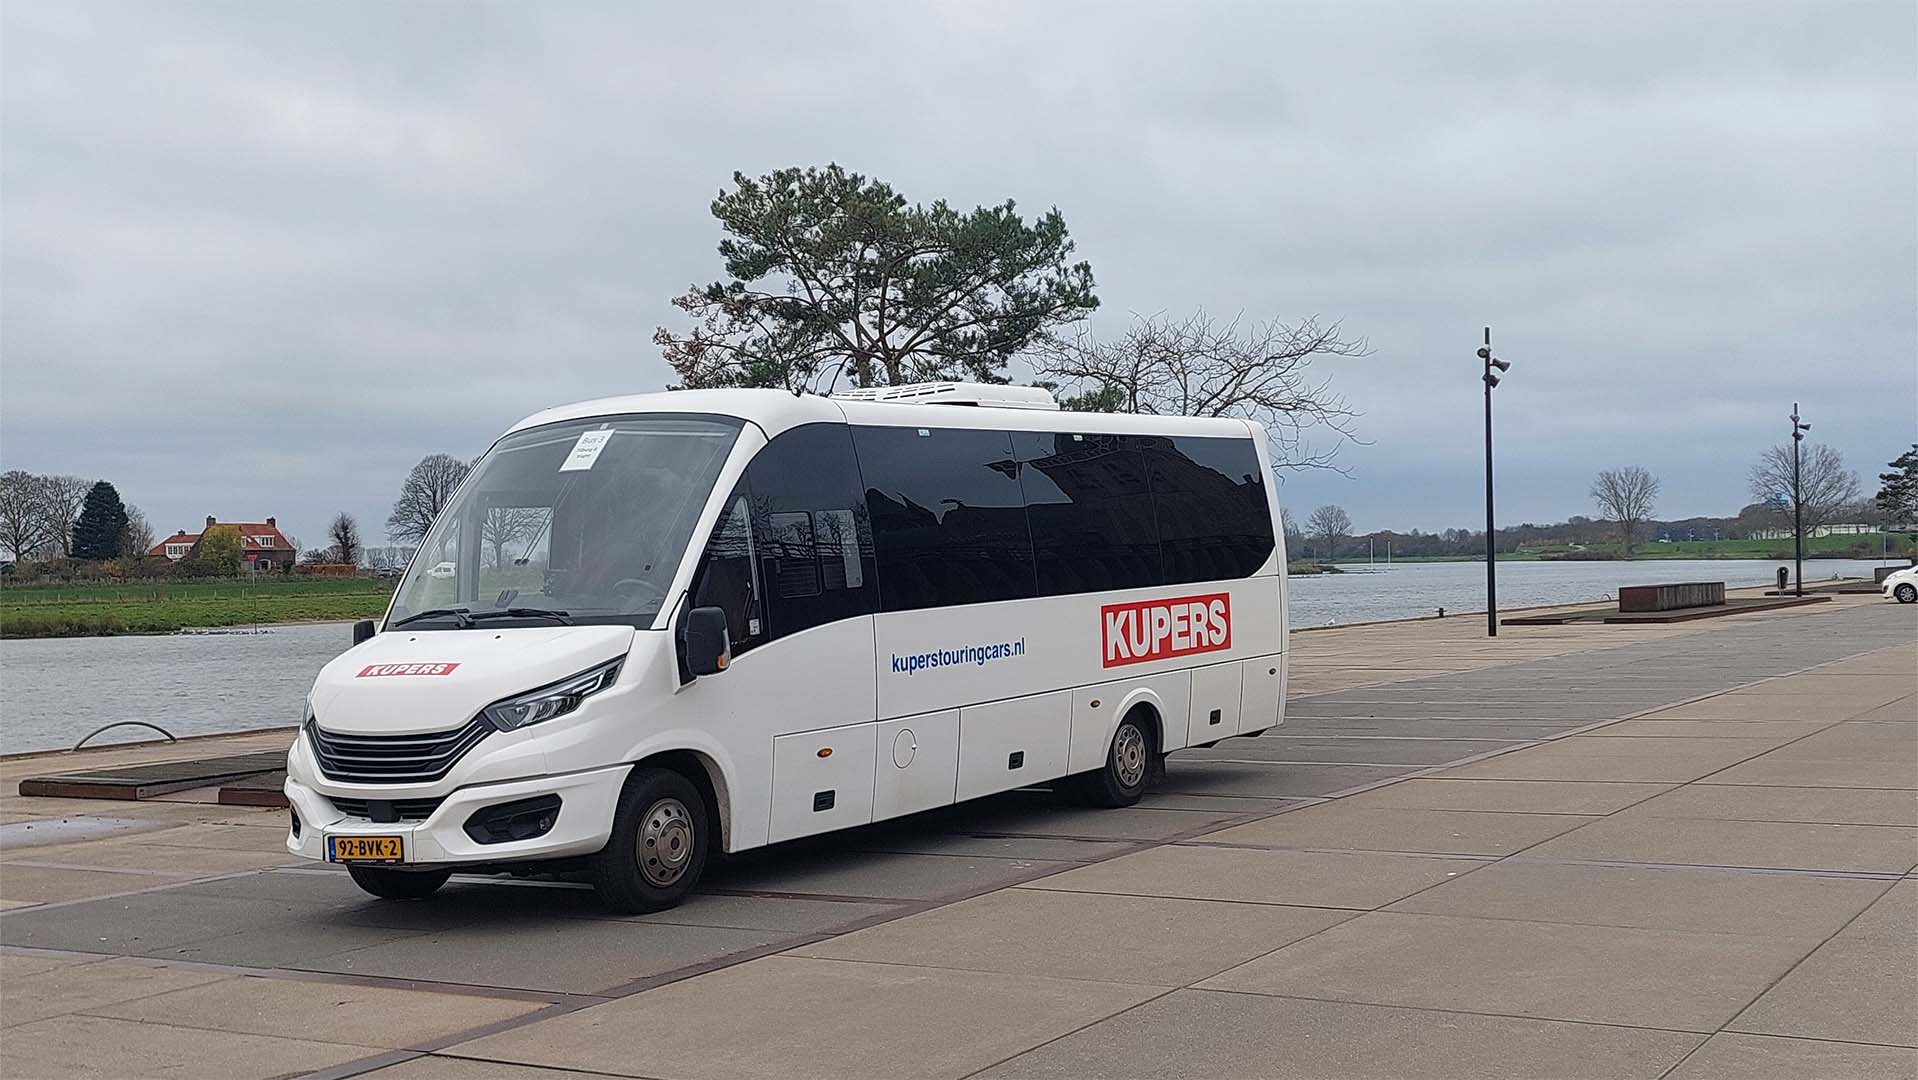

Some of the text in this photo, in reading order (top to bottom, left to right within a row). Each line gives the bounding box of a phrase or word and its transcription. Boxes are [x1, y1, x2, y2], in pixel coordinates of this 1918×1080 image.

[1105, 598, 1228, 662] KUPERS
[366, 663, 449, 677] KUPERS
[891, 637, 1026, 676] kuperstouringcars.nl
[338, 839, 398, 857] 92-BVK-2
